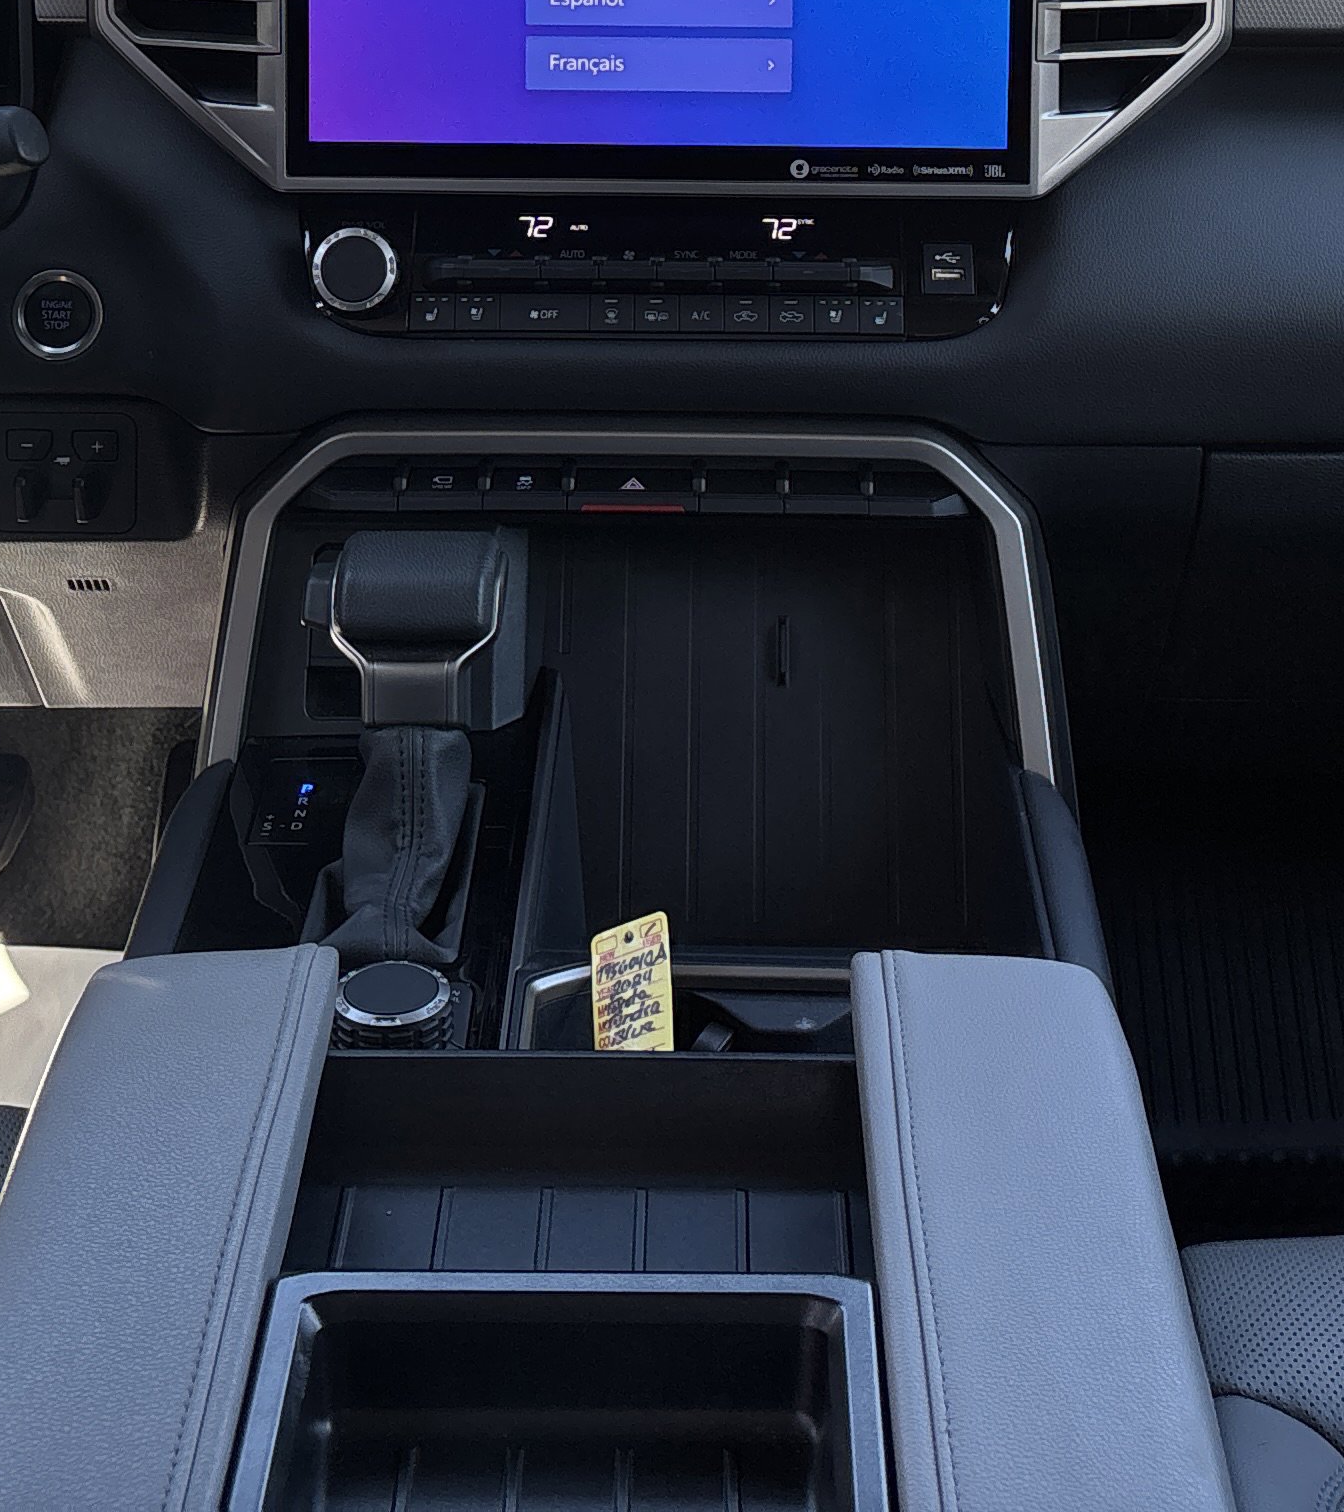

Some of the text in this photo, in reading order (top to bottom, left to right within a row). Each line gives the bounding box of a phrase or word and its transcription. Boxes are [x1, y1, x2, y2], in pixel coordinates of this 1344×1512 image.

[549, 53, 625, 76] Français
[518, 215, 554, 239] 72
[761, 217, 798, 240] 72
[559, 249, 586, 260] AUTO
[673, 250, 699, 260] SYNC
[728, 250, 759, 260] MODE
[41, 299, 73, 309] ENGINE
[41, 310, 73, 320] START
[540, 310, 559, 320] OFF
[691, 310, 711, 322] A/C
[44, 320, 70, 330] STOP
[300, 783, 314, 794] P
[297, 796, 309, 806] R
[293, 809, 307, 818] N
[261, 821, 303, 831] S D
